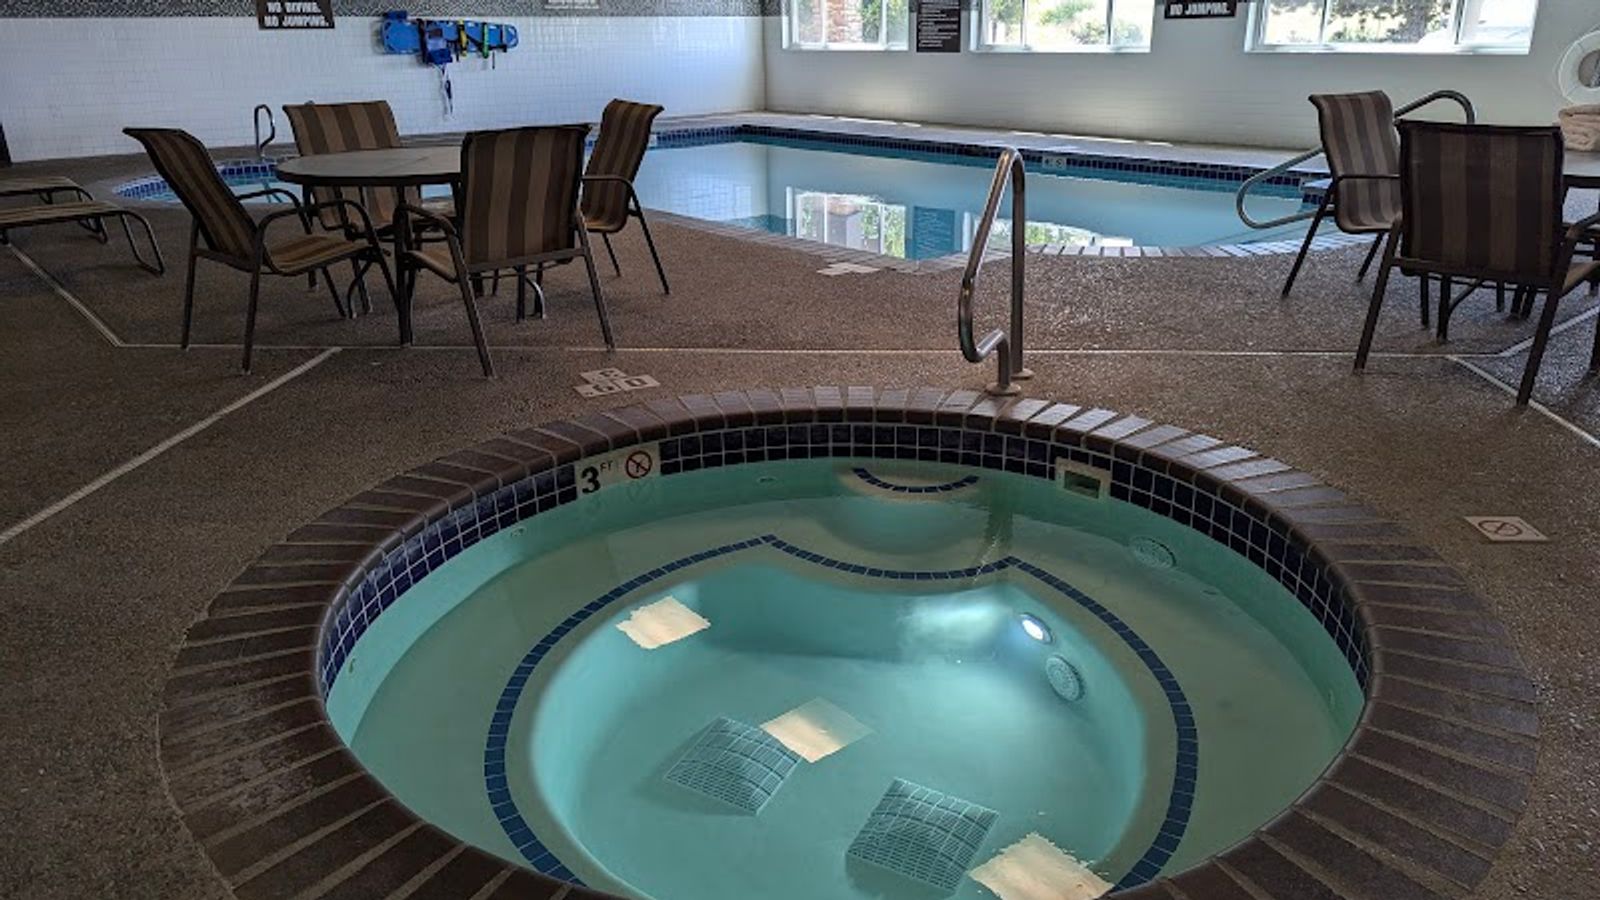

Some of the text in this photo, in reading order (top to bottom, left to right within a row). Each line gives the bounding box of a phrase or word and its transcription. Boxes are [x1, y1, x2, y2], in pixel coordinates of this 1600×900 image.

[266, 2, 282, 13] NO
[1169, 4, 1183, 15] NO
[264, 15, 280, 27] NO
[581, 461, 613, 494] 3 FT
